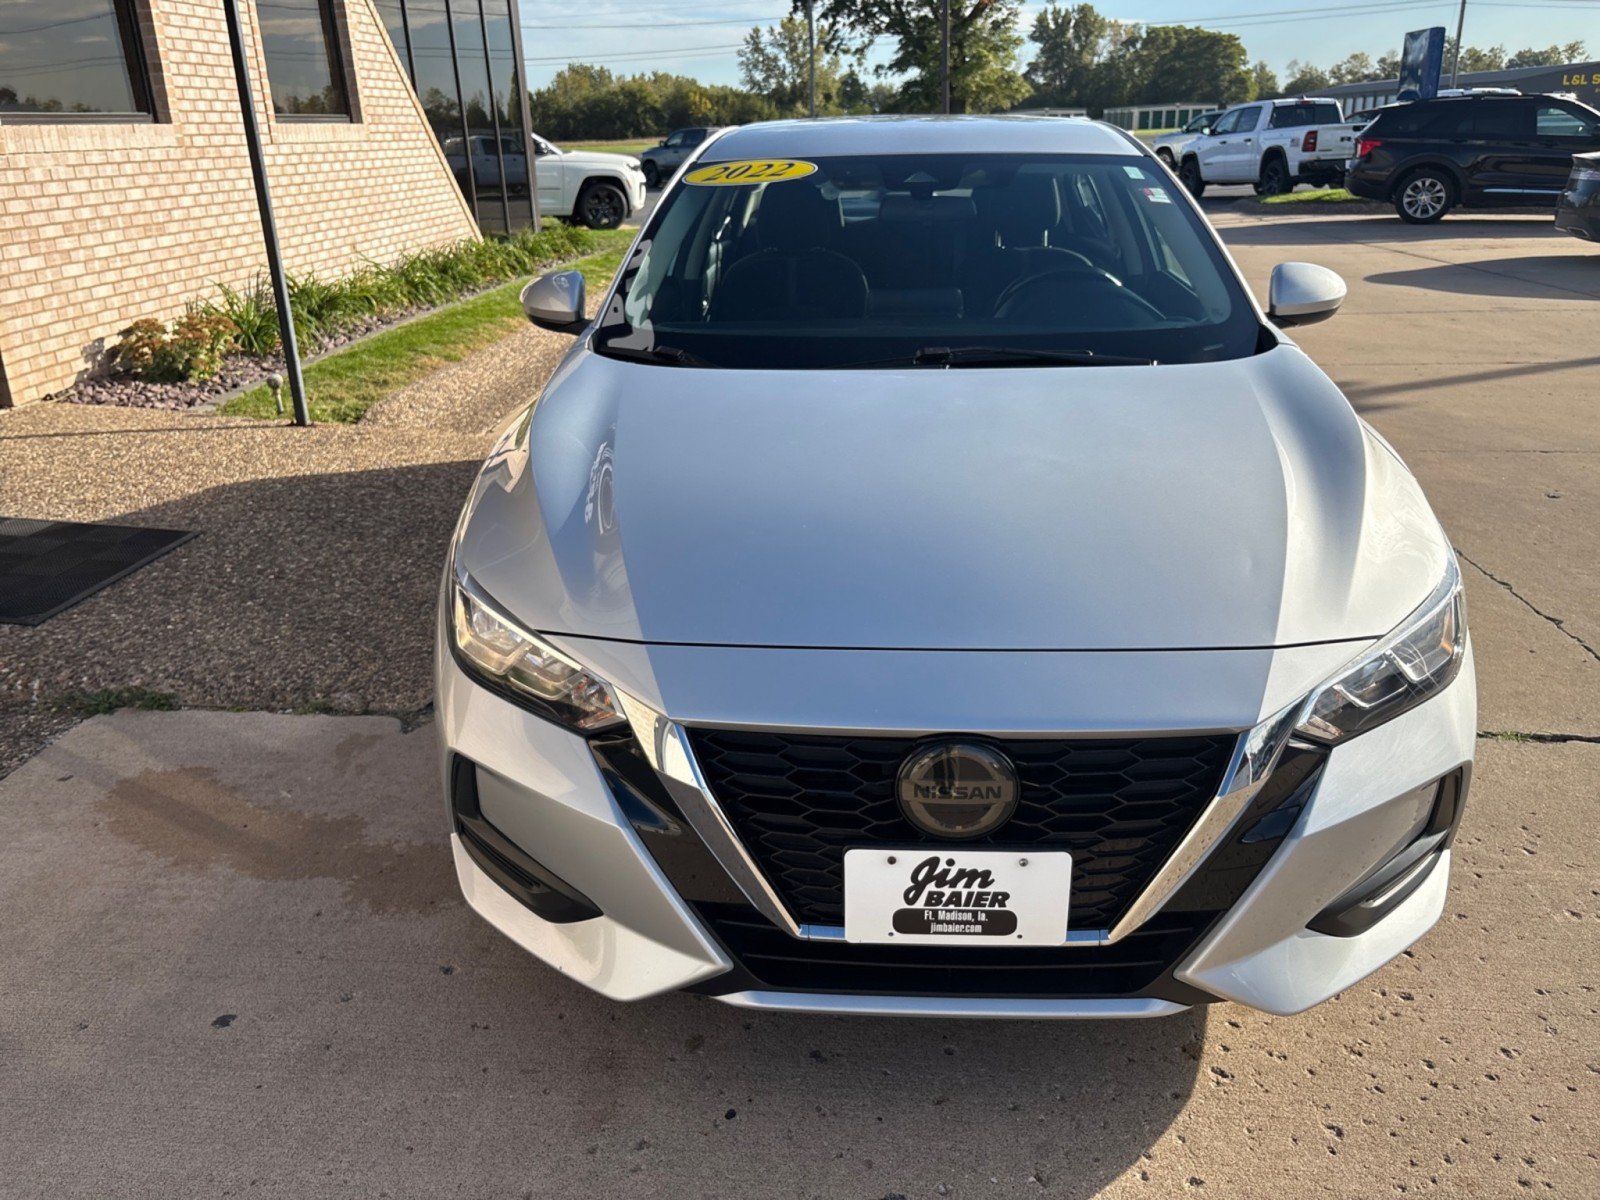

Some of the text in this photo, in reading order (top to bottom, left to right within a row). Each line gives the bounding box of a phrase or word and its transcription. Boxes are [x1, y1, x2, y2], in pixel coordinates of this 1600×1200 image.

[702, 163, 795, 182] 2022
[913, 784, 1002, 800] NISSAN
[903, 856, 995, 906] Jim
[923, 891, 1011, 908] BAIER
[924, 910, 935, 920] Ft.
[938, 911, 975, 922] Madison,
[930, 922, 982, 933] jimbaier.com
